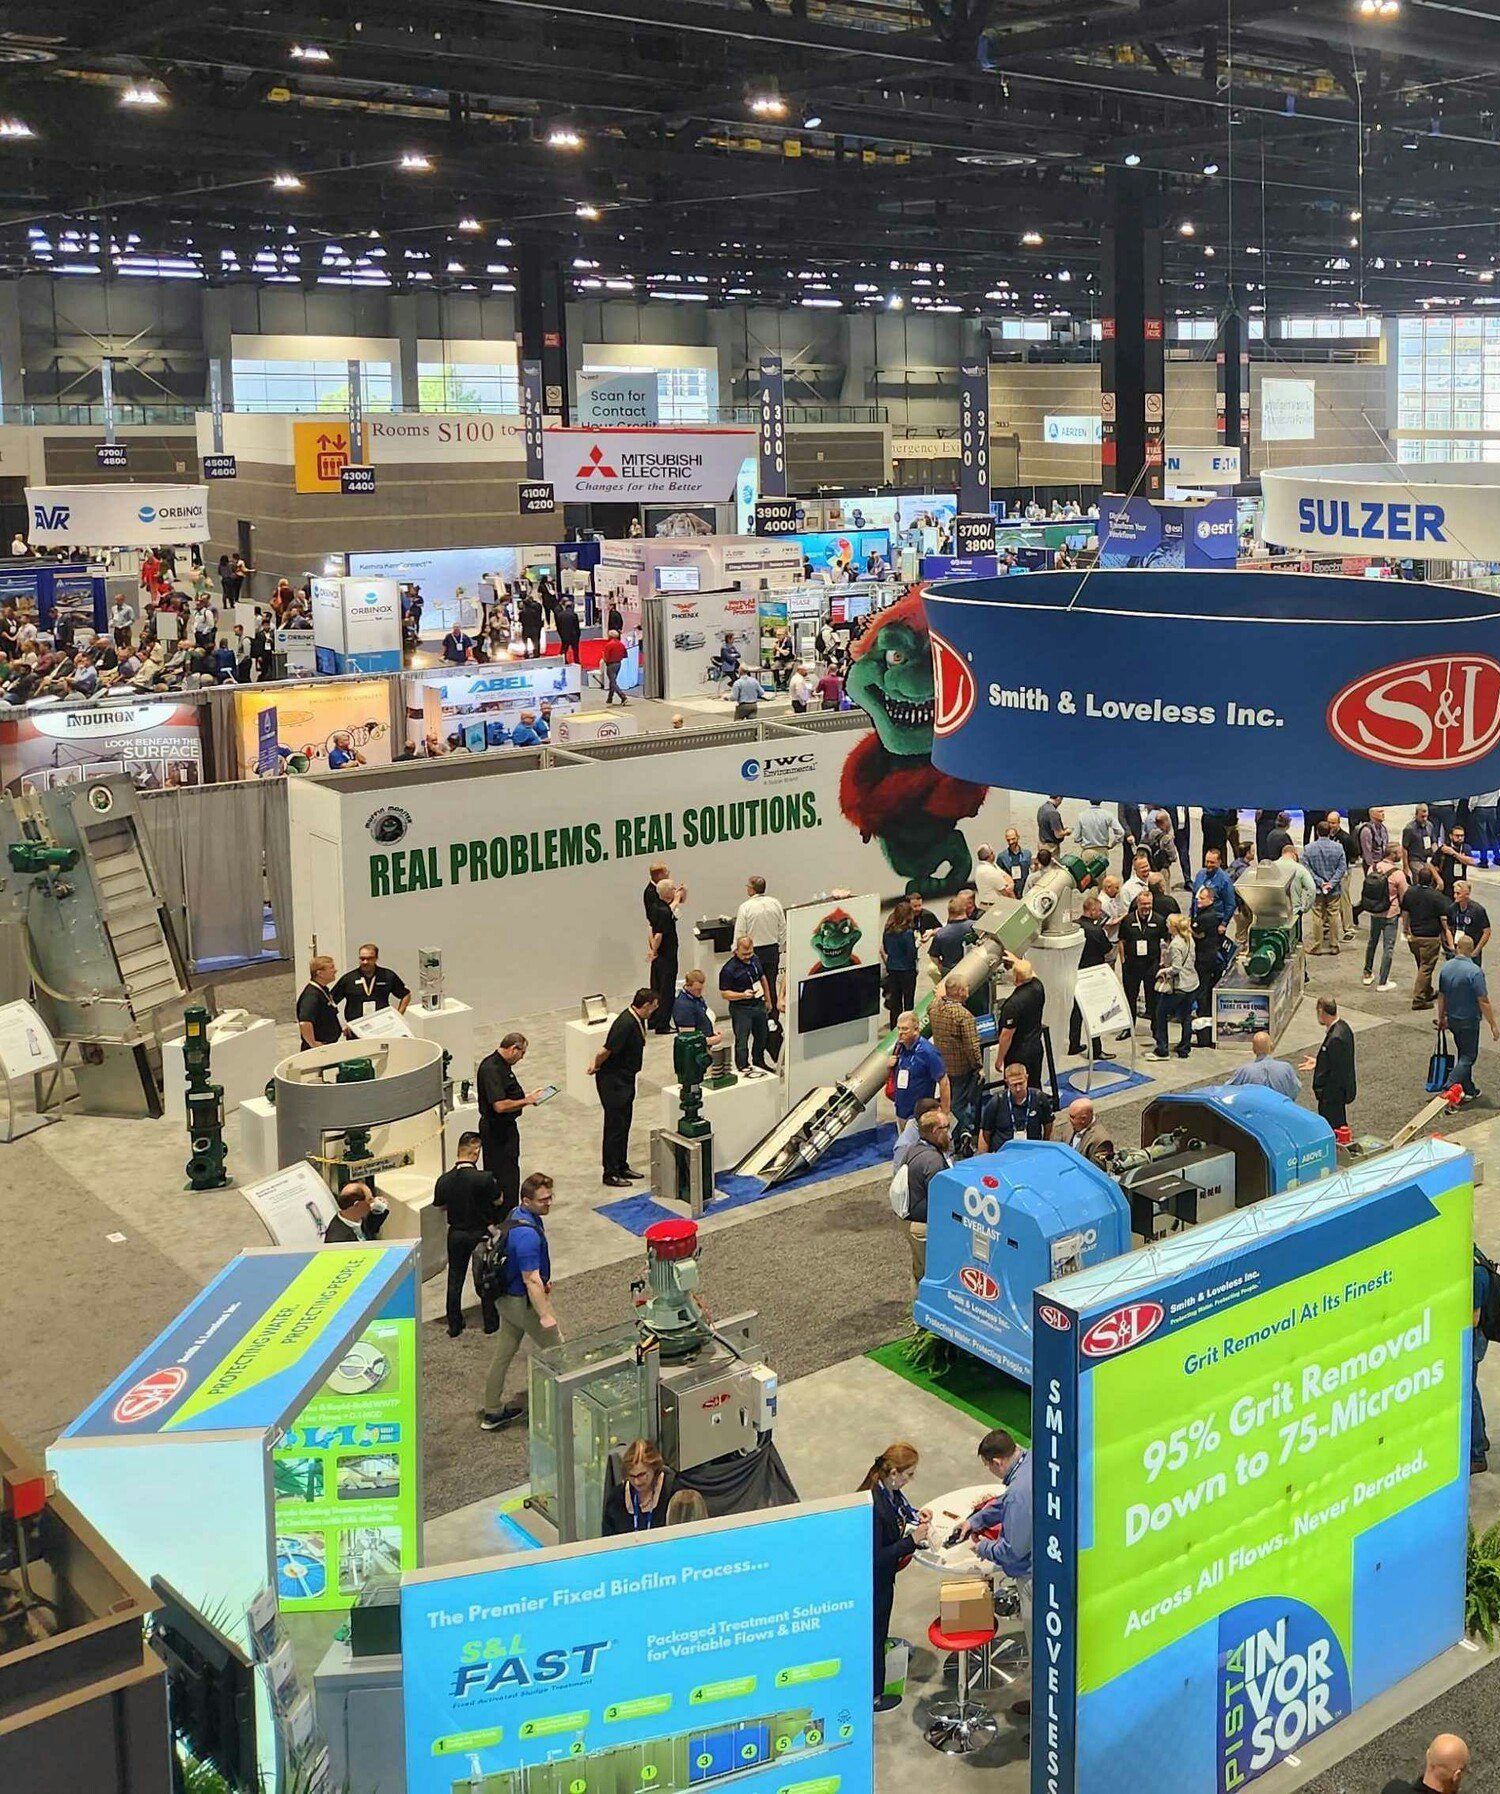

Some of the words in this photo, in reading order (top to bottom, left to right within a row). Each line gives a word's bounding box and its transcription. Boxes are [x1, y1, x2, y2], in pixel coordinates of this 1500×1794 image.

[591, 391, 623, 401] Scan
[627, 390, 645, 401] for
[592, 406, 646, 417] Contact
[762, 389, 771, 455] 4000
[372, 422, 430, 437] Rooms
[438, 422, 494, 443] S100
[774, 405, 783, 472] 3900
[963, 392, 972, 466] 3800
[1062, 427, 1087, 437] AERZEN
[621, 454, 702, 466] MITSUBISHI
[977, 410, 986, 486] 3700
[342, 471, 371, 481] 4300/
[348, 481, 375, 491] 4400
[576, 481, 624, 492] Changes
[628, 481, 642, 492] for
[648, 482, 664, 491] the
[669, 482, 702, 491] Better
[622, 467, 692, 478] ELECTRIC
[521, 488, 550, 499] 4100/
[527, 499, 553, 510] 4200
[34, 506, 70, 530] AVK
[757, 507, 791, 518] 3900/
[764, 520, 795, 531] 4000
[1211, 519, 1234, 535] esri
[1299, 498, 1447, 542] SULZER
[959, 525, 991, 537] 3700/
[965, 539, 995, 552] 3800
[351, 605, 392, 615] ORBINOX
[469, 676, 534, 693] ABEL
[989, 683, 1050, 712] Smith
[1057, 691, 1077, 714] &
[1086, 694, 1217, 725] Loveless
[1227, 702, 1284, 727] Inc.
[105, 740, 133, 748] LOOK
[135, 738, 180, 746] BENEATH
[182, 737, 200, 745] THE
[123, 746, 199, 759] SURFACE
[764, 753, 814, 770] JWC
[370, 847, 443, 898] REAL
[450, 823, 609, 886] PROBLEMS.
[615, 810, 677, 859] REAL
[683, 791, 823, 846] SOLUTIONS.
[962, 1217, 1001, 1241] EVERLAST
[282, 1286, 338, 1344] PROTECTING
[328, 1257, 366, 1297] PEOPLE.
[1170, 1297, 1196, 1313] Smith
[1206, 1277, 1243, 1298] Loveless
[1244, 1270, 1260, 1282] Inc.
[1041, 1307, 1070, 1330] S&L
[1089, 1303, 1158, 1356] S&L
[1183, 1346, 1219, 1376] Grit
[1223, 1314, 1296, 1360] Removal
[1300, 1300, 1320, 1324] At
[1322, 1292, 1341, 1314] Its
[1344, 1269, 1393, 1308] Finest:
[208, 1337, 267, 1395] PROTECTING
[1142, 1416, 1221, 1484] 95%
[1229, 1380, 1294, 1437] Grit
[1302, 1307, 1431, 1394] Removal
[1045, 1380, 1063, 1521] SMITH
[1125, 1473, 1227, 1548] Down
[1235, 1450, 1269, 1488] to
[1278, 1357, 1446, 1466] 75-Microns
[1046, 1536, 1063, 1563] &
[1124, 1583, 1192, 1639] Across
[1196, 1560, 1224, 1597] All
[1227, 1534, 1289, 1578] Flows.
[1293, 1497, 1349, 1542] Never
[1352, 1448, 1429, 1508] Derated.
[427, 1610, 465, 1629] The
[468, 1596, 548, 1624] Premier
[553, 1582, 606, 1607] Fixed
[611, 1568, 677, 1598] Biofilm
[682, 1557, 769, 1586] Process...
[647, 1625, 716, 1648] Packaged
[718, 1611, 789, 1632] Treatment
[792, 1599, 855, 1619] Solutions
[462, 1634, 527, 1663] S&L
[647, 1649, 670, 1662] for
[671, 1635, 732, 1657] Variable
[734, 1629, 774, 1645] Flows
[778, 1625, 790, 1636] &
[791, 1618, 821, 1633] BNR
[1243, 1617, 1288, 1685] IN
[453, 1640, 611, 1698] FAST
[1246, 1638, 1334, 1721] VOR
[1045, 1583, 1063, 1794] LOVELESS
[1225, 1647, 1246, 1793] PISTA
[1249, 1683, 1336, 1773] SOR
